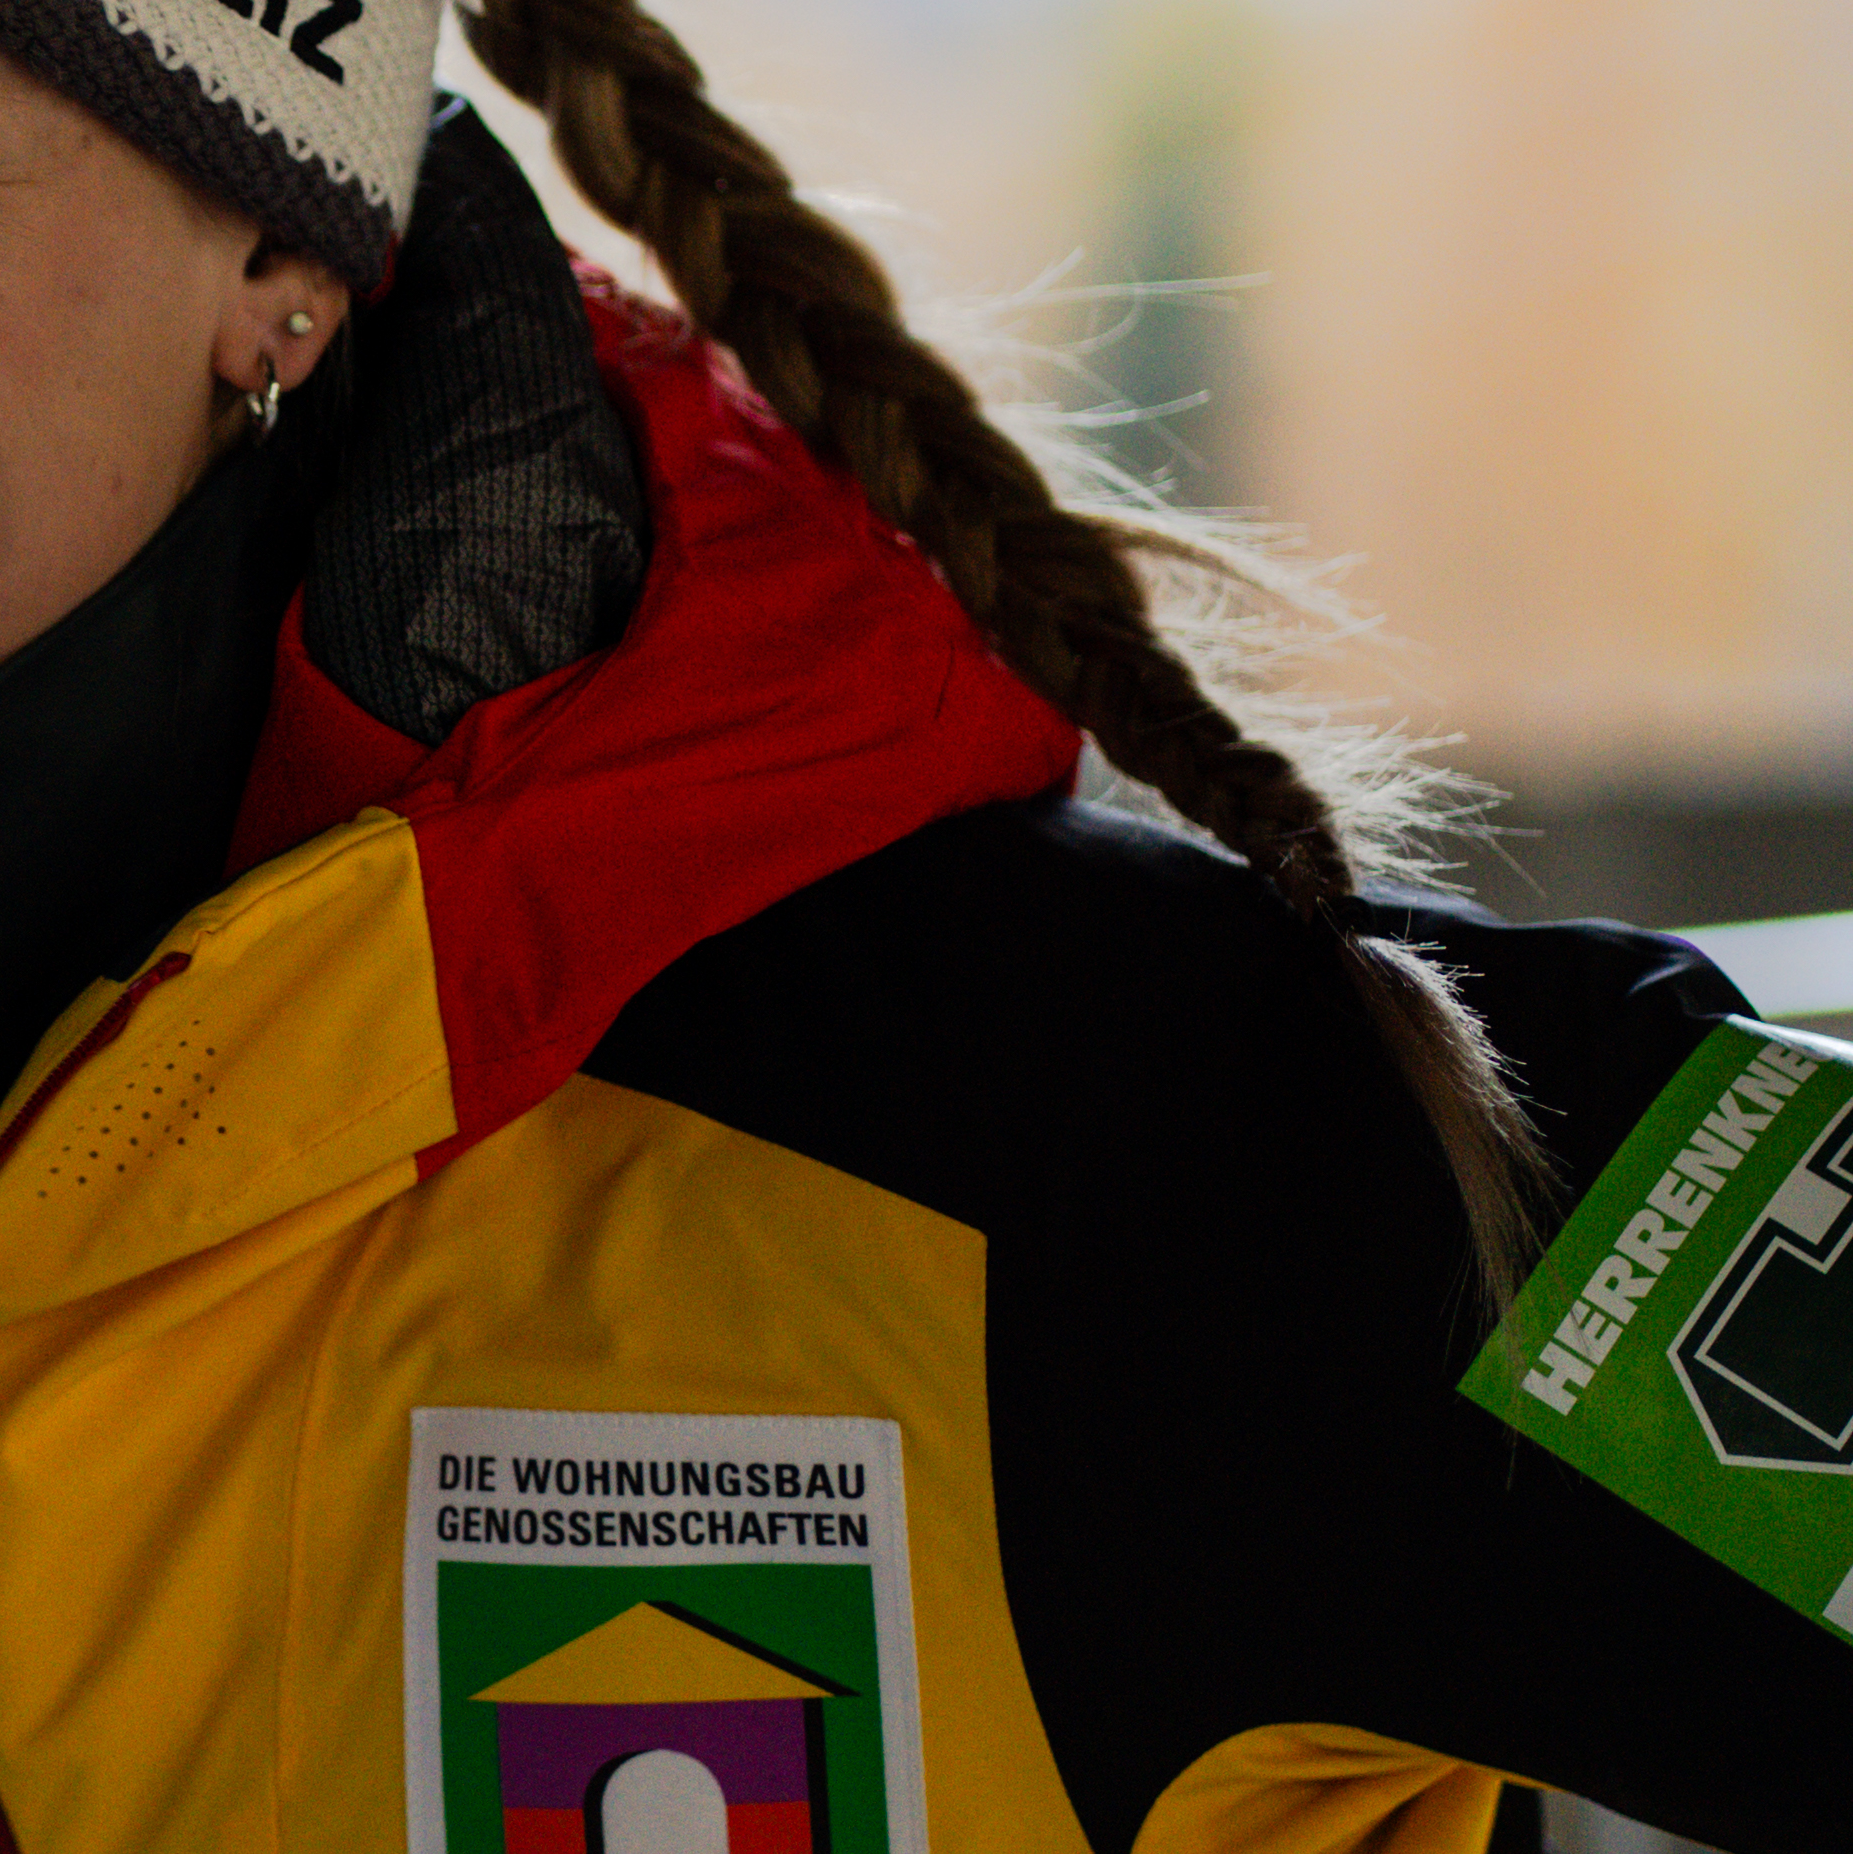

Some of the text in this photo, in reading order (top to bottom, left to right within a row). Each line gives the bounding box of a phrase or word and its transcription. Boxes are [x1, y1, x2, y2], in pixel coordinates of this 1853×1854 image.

[437, 1454, 865, 1500] DIE WOHNUNGSBAU
[436, 1505, 869, 1547] GENOSSENSCHAFTEN
